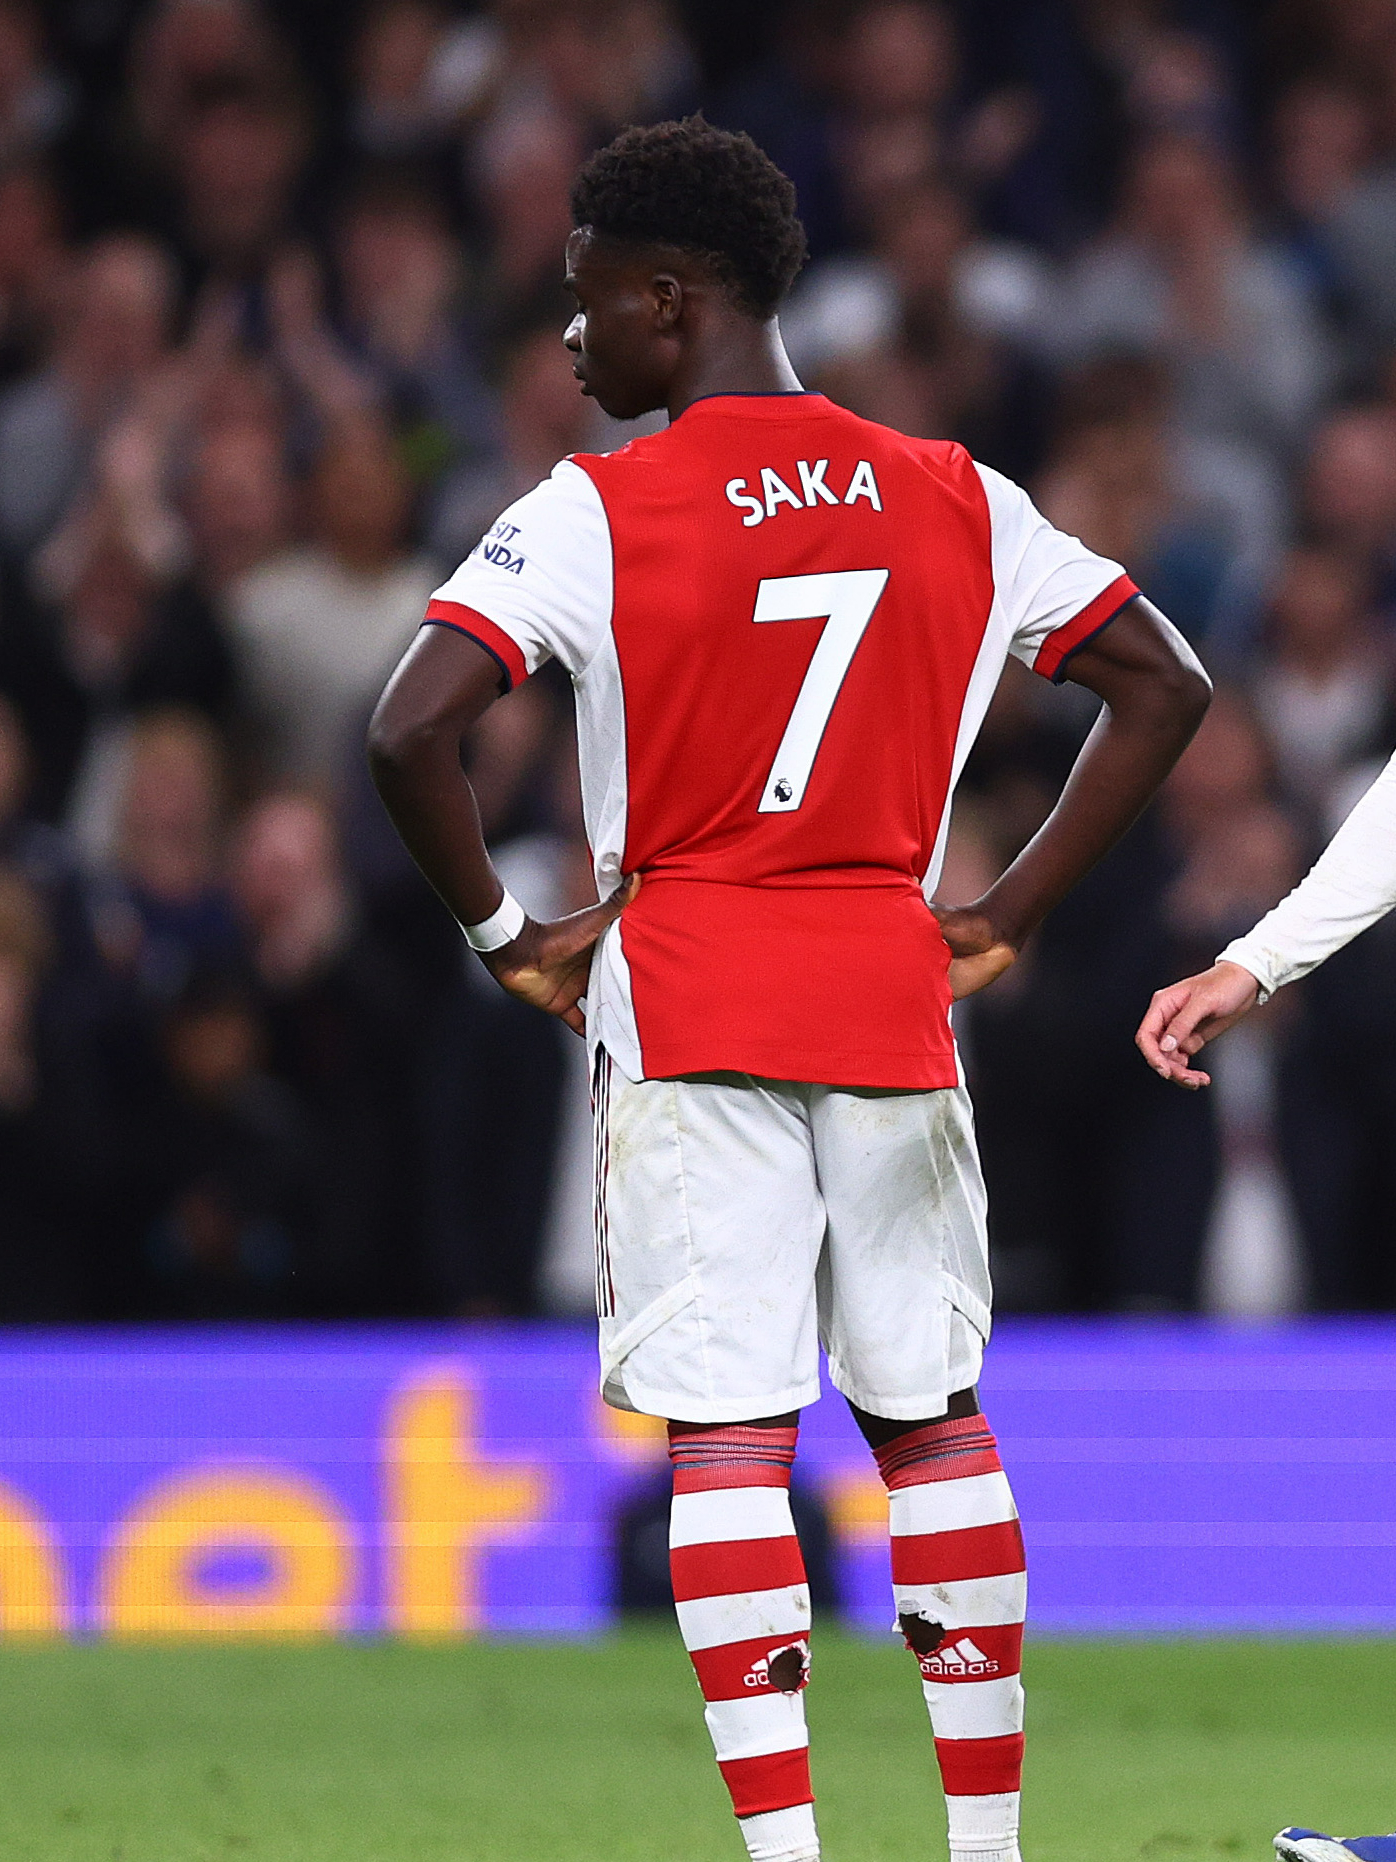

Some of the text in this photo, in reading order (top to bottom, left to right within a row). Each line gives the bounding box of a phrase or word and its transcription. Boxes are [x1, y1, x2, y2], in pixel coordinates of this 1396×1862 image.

[725, 458, 884, 528] SAKA
[472, 541, 526, 575] NDA
[752, 568, 890, 814] 7
[920, 1659, 999, 1676] adidas
